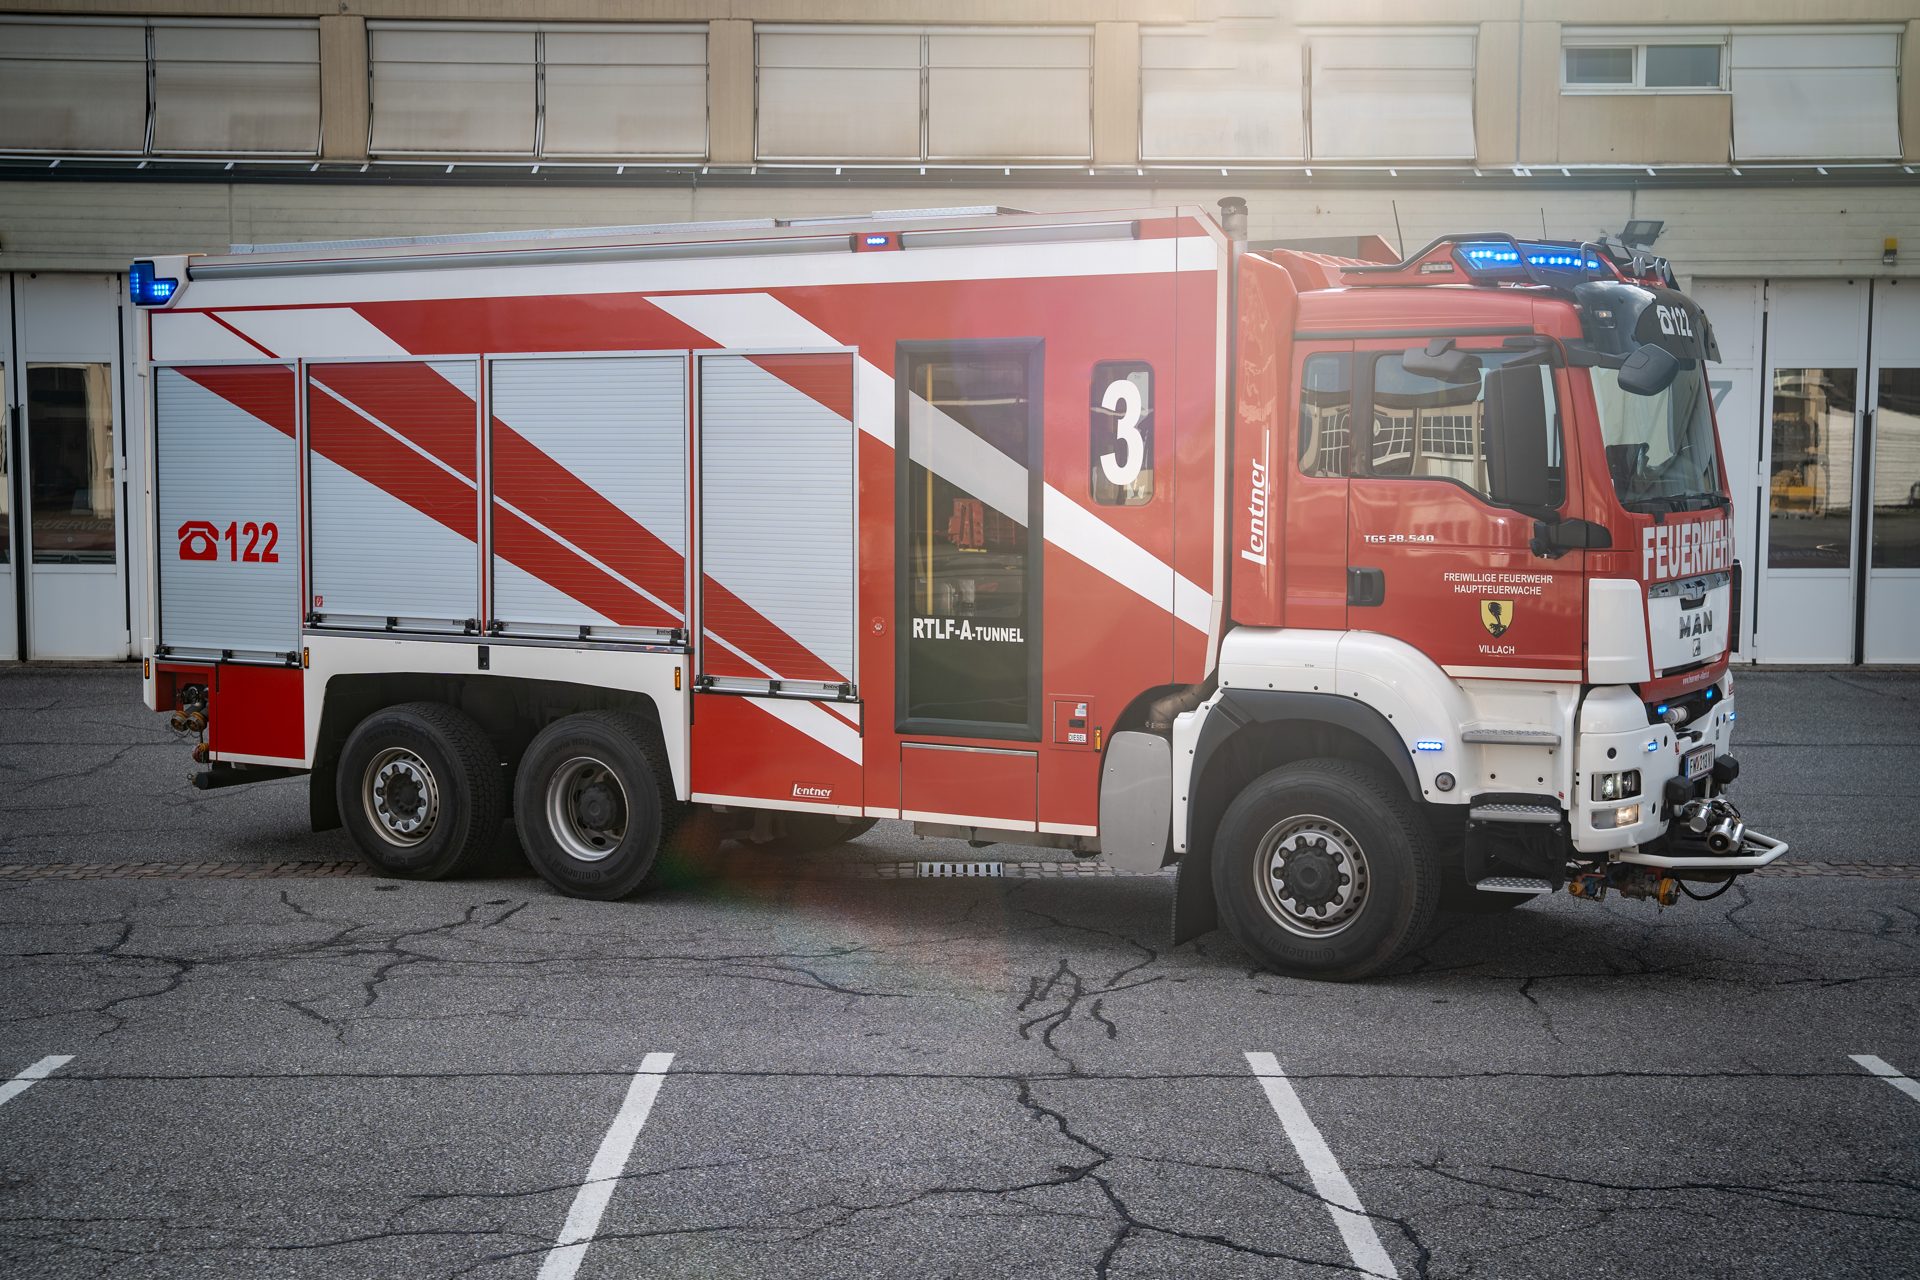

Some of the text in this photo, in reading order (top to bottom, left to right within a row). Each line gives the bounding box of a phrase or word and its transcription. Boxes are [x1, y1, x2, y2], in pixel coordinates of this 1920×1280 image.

[1671, 306, 1693, 337] 122
[1100, 379, 1144, 486] 3
[224, 521, 279, 563] 122
[1363, 534, 1435, 543] TGS 28.540
[1444, 572, 1553, 584] FREIWILLIGE FEUERWEHR
[1454, 584, 1542, 595] HAUPTFEUERWACHE
[1679, 610, 1712, 640] MAN
[1478, 644, 1516, 655] VILLACH
[1068, 734, 1086, 742] DIESEL
